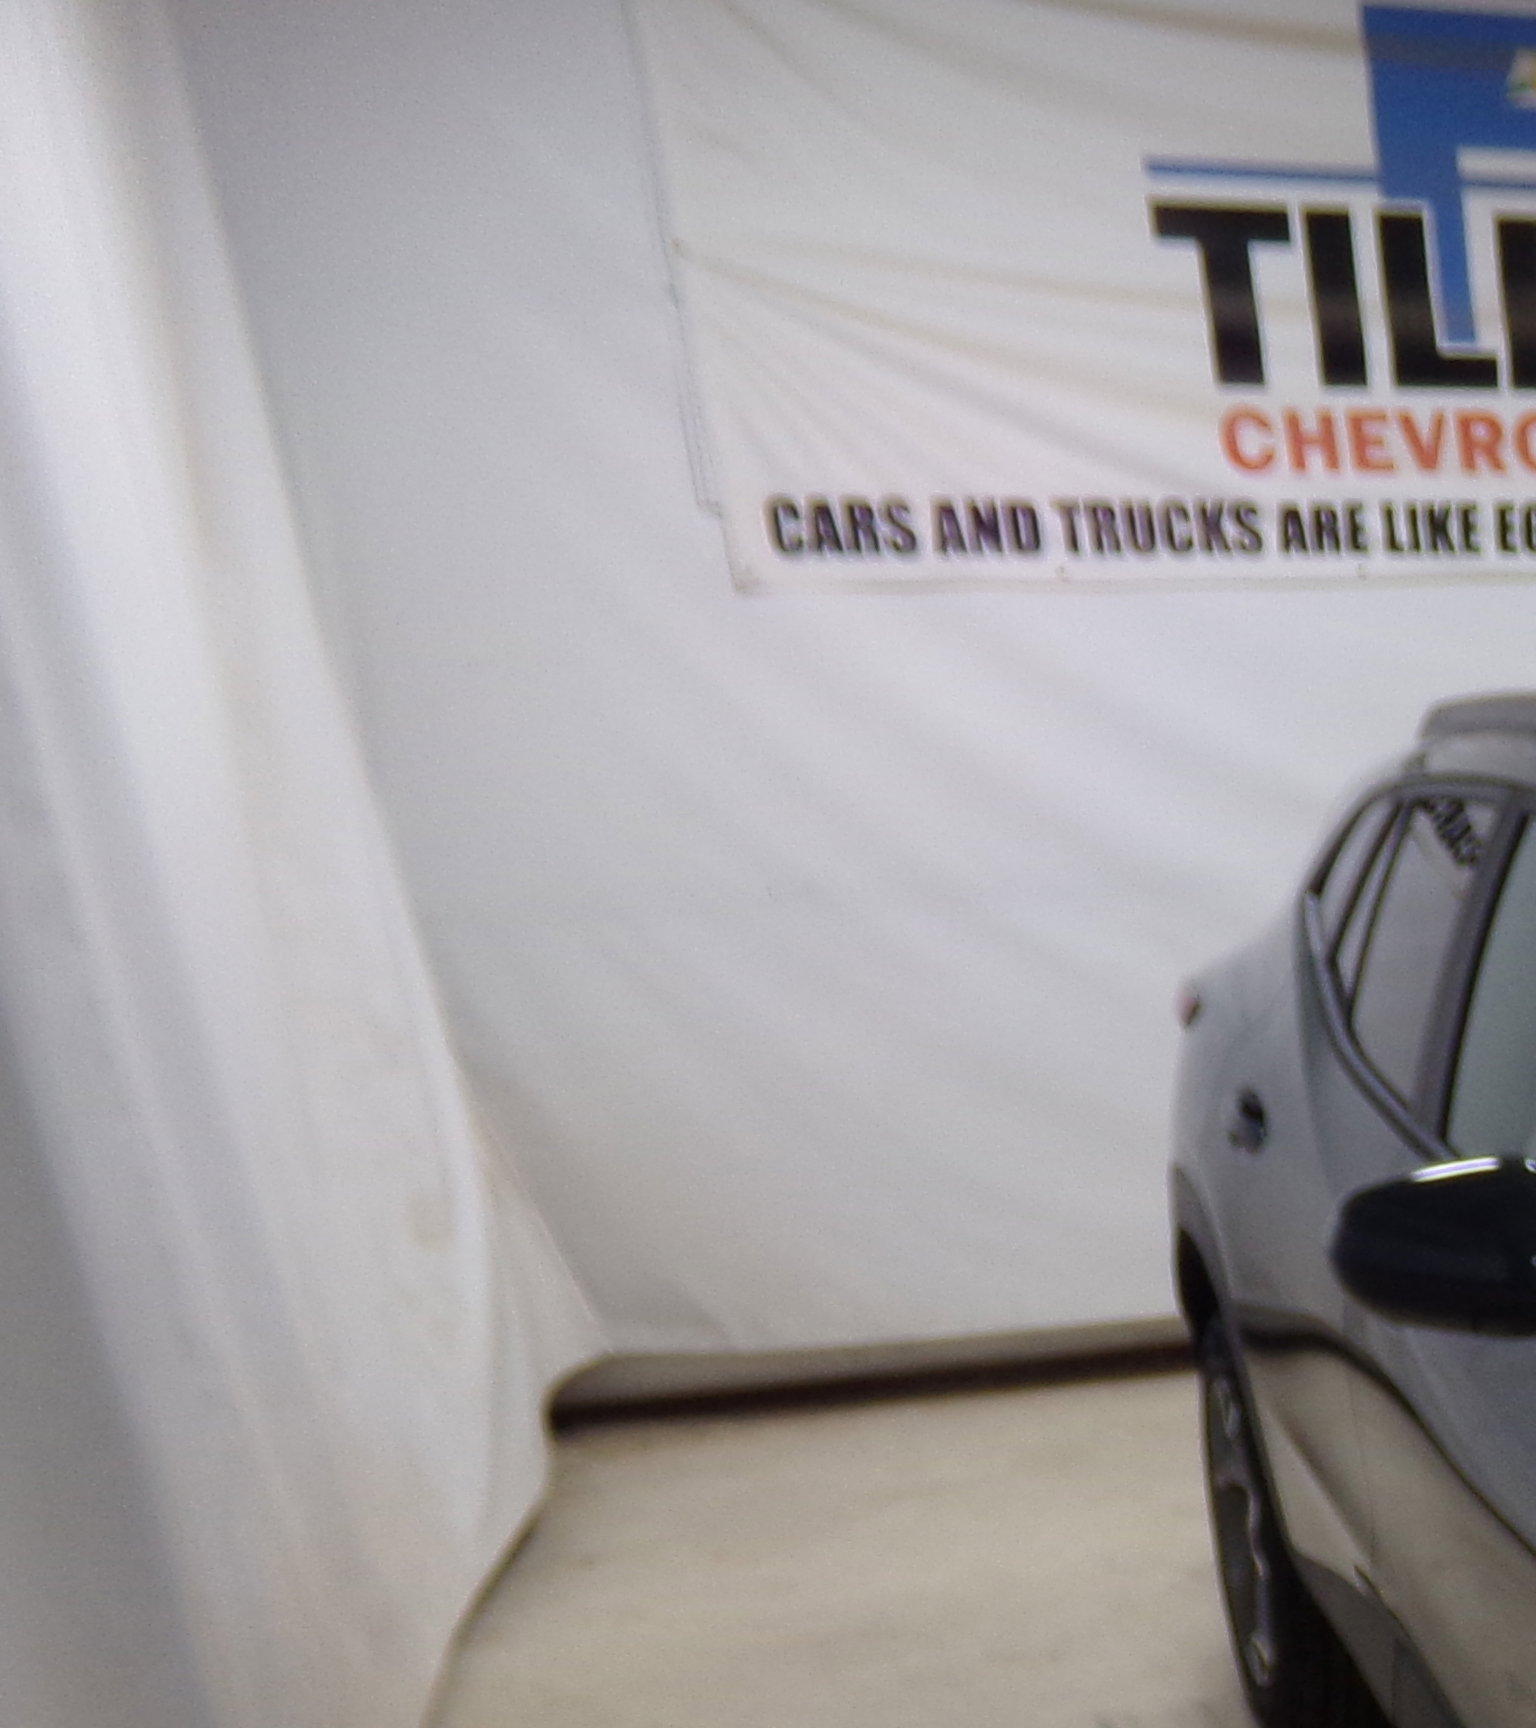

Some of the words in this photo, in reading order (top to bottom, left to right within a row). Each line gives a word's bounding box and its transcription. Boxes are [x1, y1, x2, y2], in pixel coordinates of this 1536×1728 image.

[768, 499, 918, 556] CARS
[932, 499, 1041, 555] AND
[1055, 499, 1264, 555] TRUCKS
[1279, 501, 1368, 555] ARE
[1381, 501, 1479, 555] LIKE
